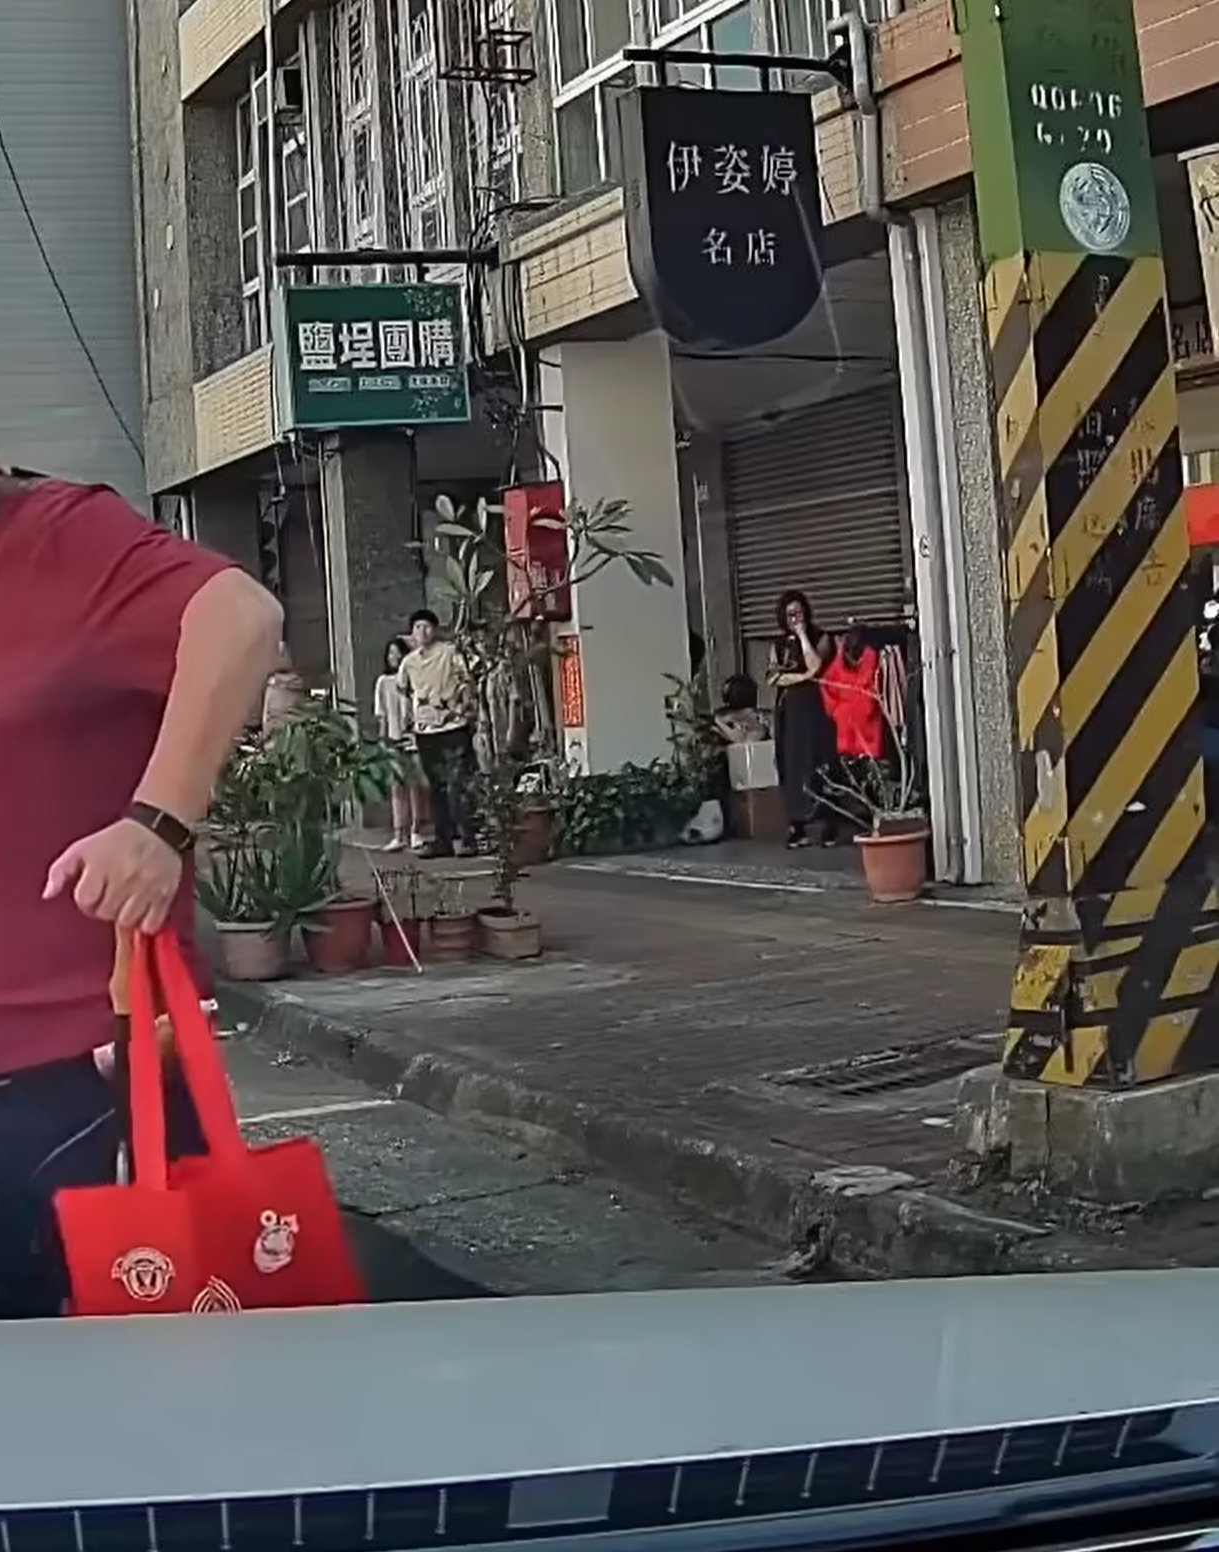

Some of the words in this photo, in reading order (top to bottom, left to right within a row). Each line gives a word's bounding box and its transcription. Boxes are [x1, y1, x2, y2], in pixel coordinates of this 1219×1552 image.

[700, 227, 777, 266] 名店
[297, 319, 456, 371] 鹽埕團購
